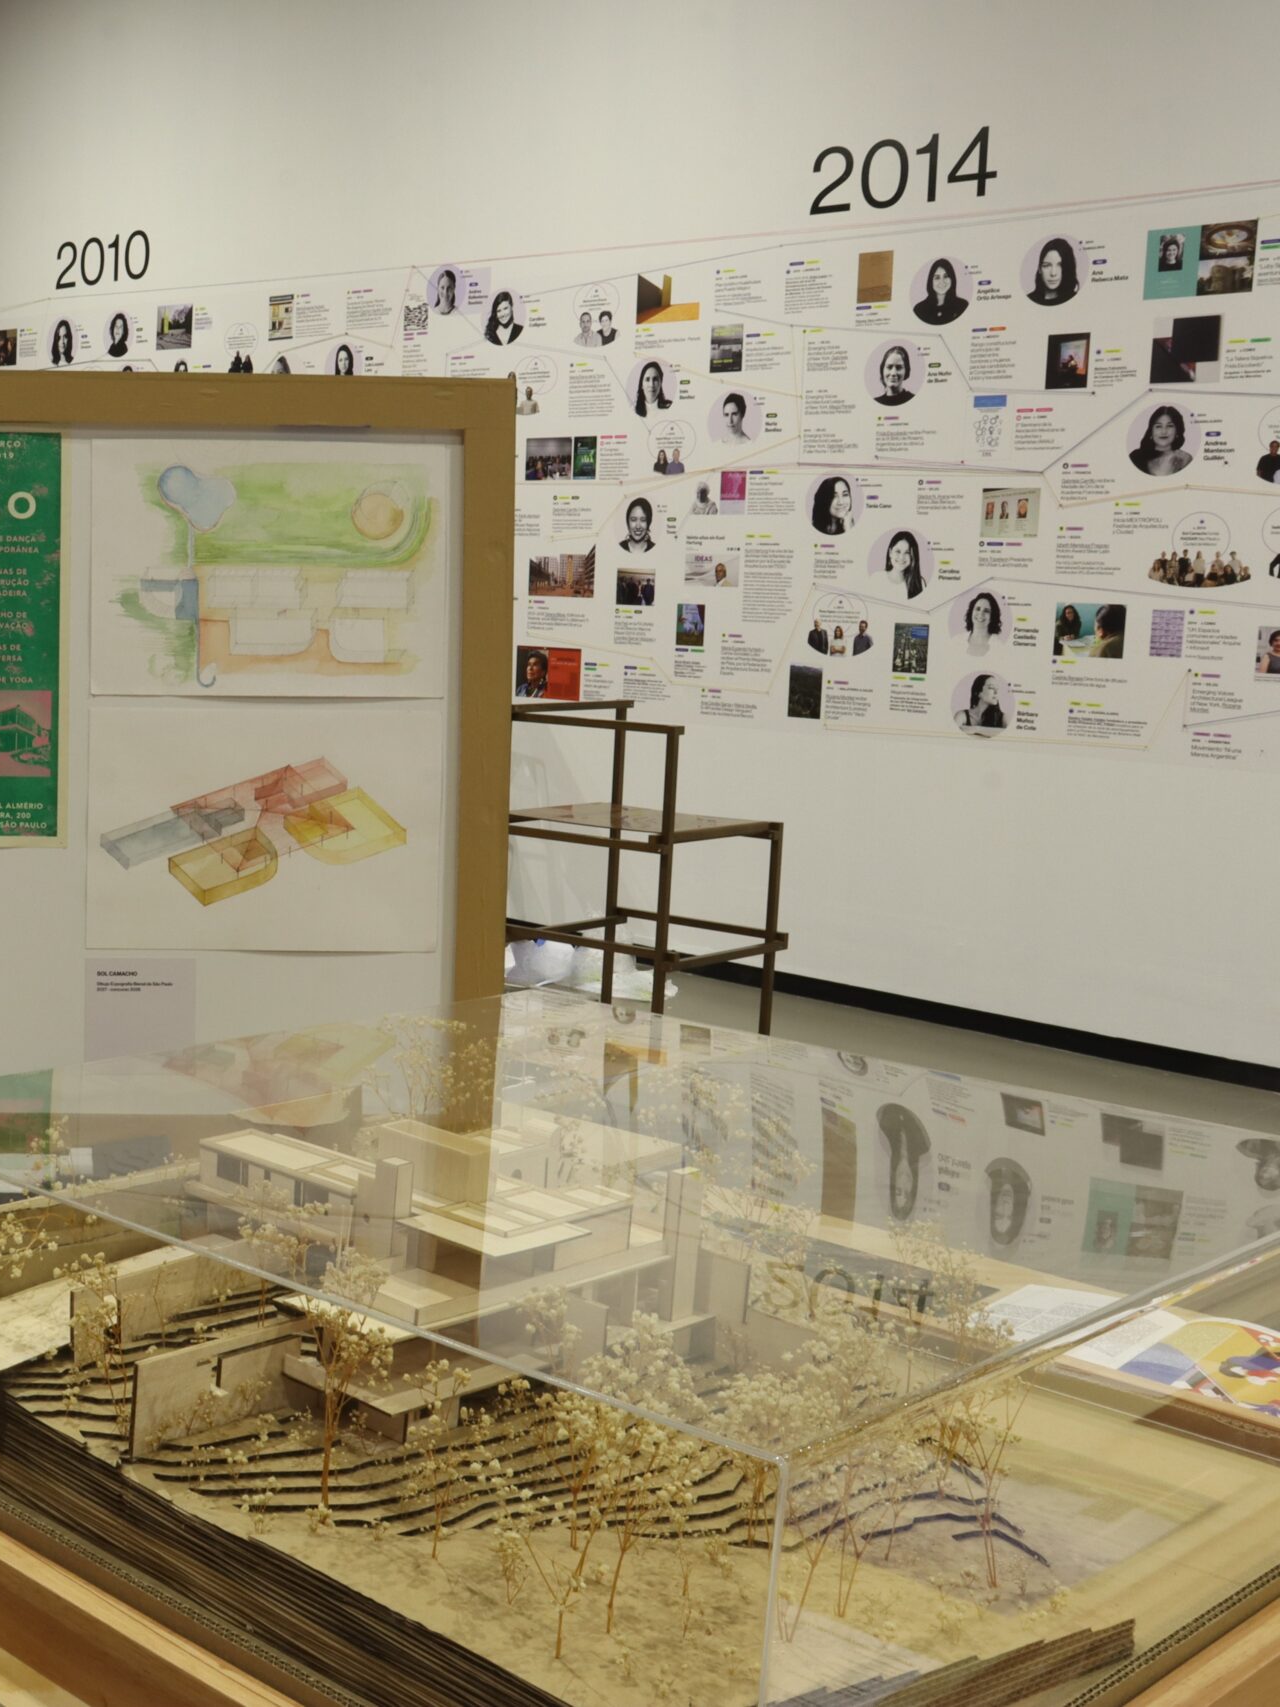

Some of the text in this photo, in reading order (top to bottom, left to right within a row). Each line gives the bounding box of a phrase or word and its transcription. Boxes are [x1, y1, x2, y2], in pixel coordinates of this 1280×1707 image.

[809, 126, 998, 215] 2014
[55, 229, 150, 290] 2010
[5, 535, 36, 544] DANÇA
[9, 676, 33, 684] YOGA
[4, 801, 44, 810] ALMÉRIO
[16, 811, 32, 819] 200
[0, 819, 17, 829] SÃO
[18, 821, 48, 829] PAULO
